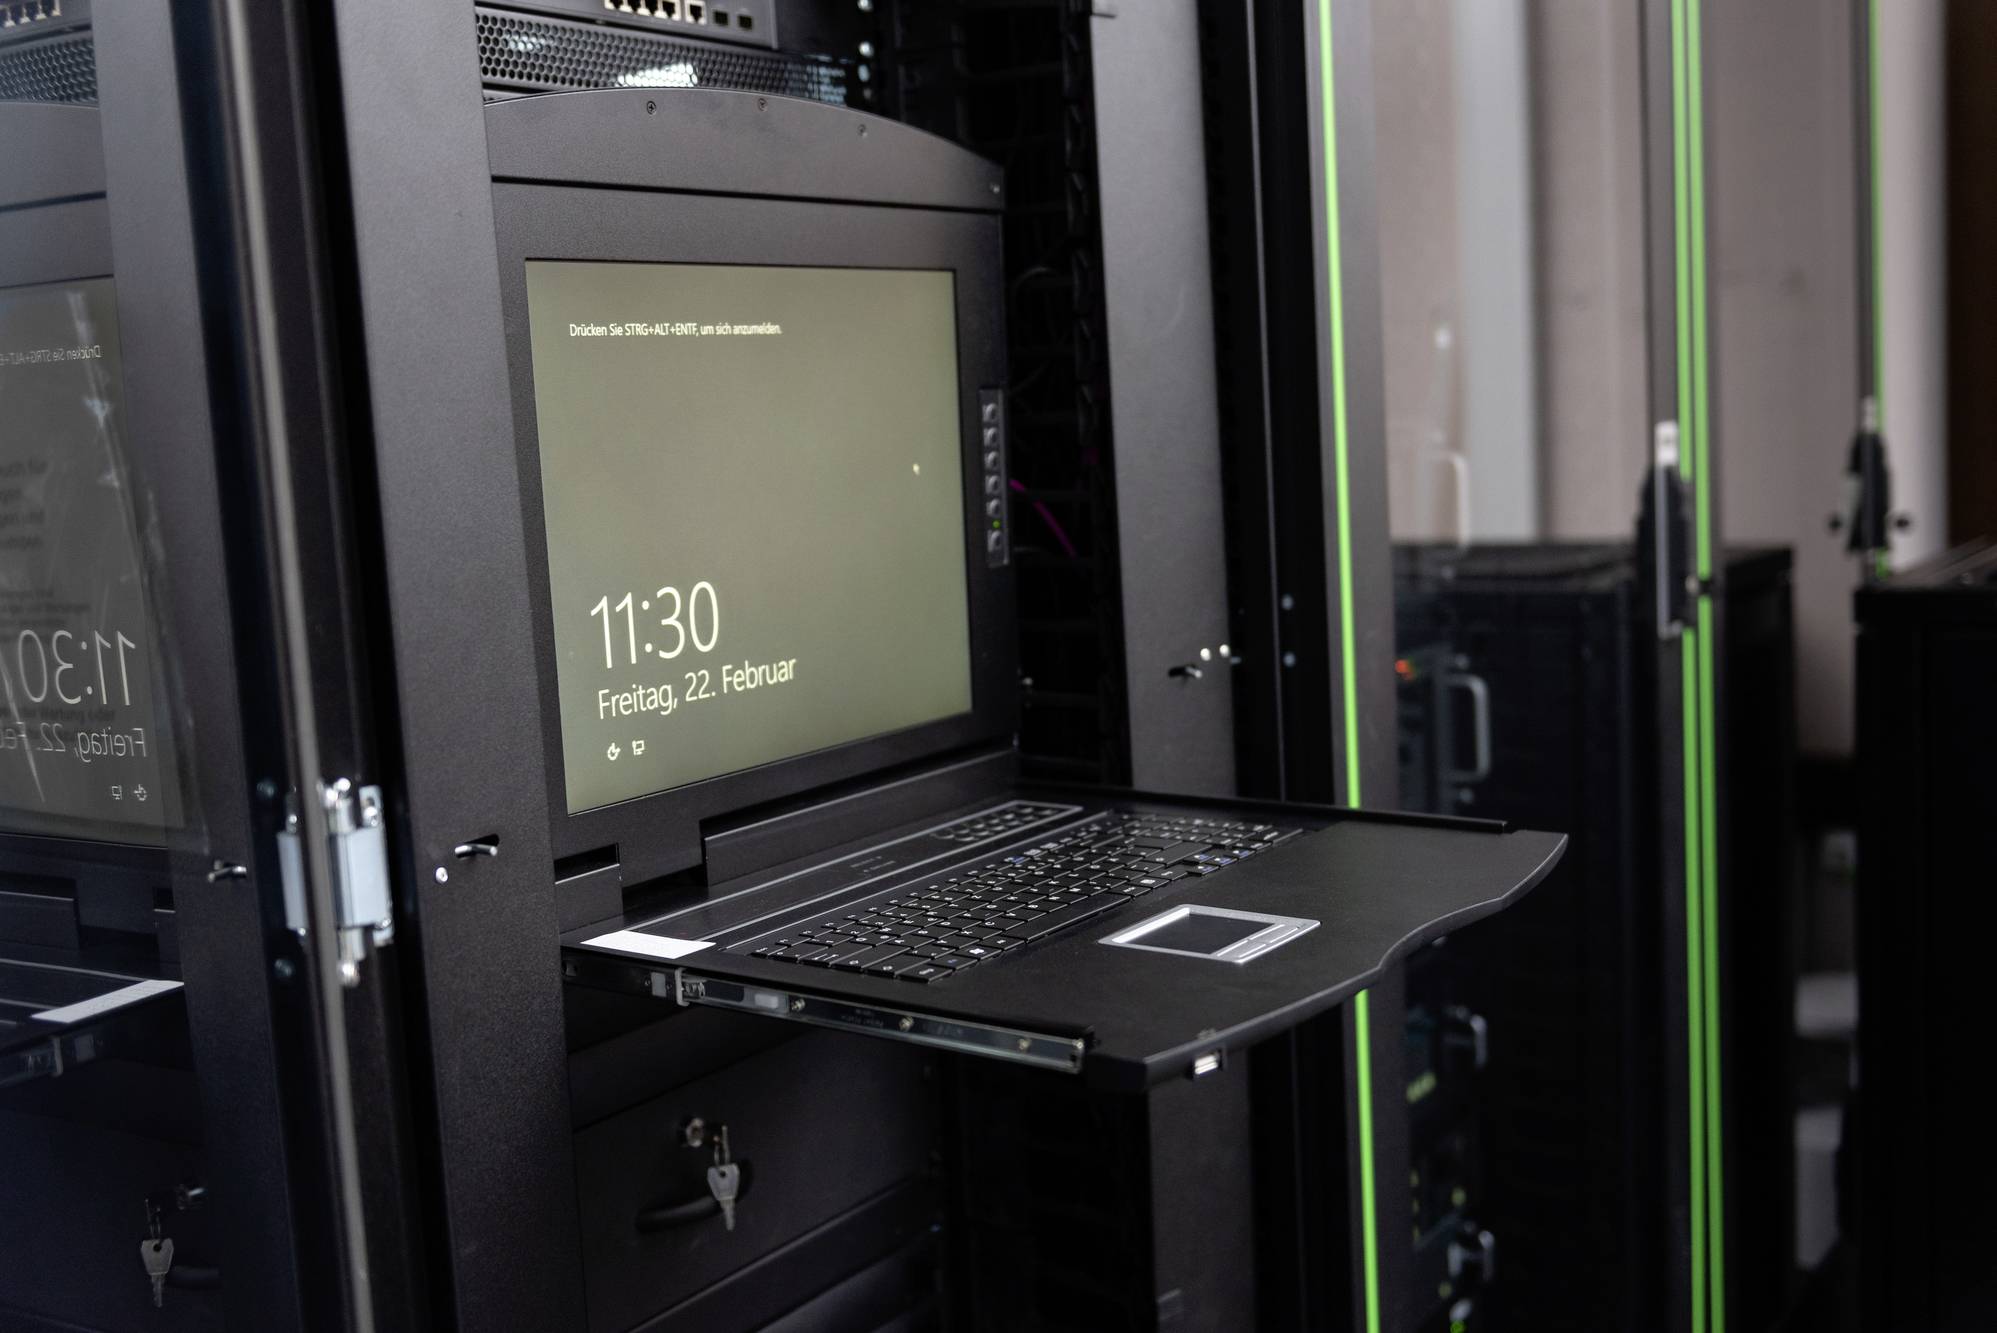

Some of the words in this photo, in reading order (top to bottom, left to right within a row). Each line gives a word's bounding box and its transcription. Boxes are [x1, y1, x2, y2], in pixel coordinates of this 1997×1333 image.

[569, 322, 608, 337] Drücken
[609, 322, 623, 336] Sie
[624, 322, 699, 337] STRG+ALT+ENTF,
[700, 324, 715, 336] um
[716, 322, 732, 336] sich
[732, 322, 783, 336] anzumelden.
[590, 581, 719, 669] 11:30
[598, 683, 678, 720] Freitag,
[684, 669, 716, 702] 22.
[722, 658, 797, 694] Februar
